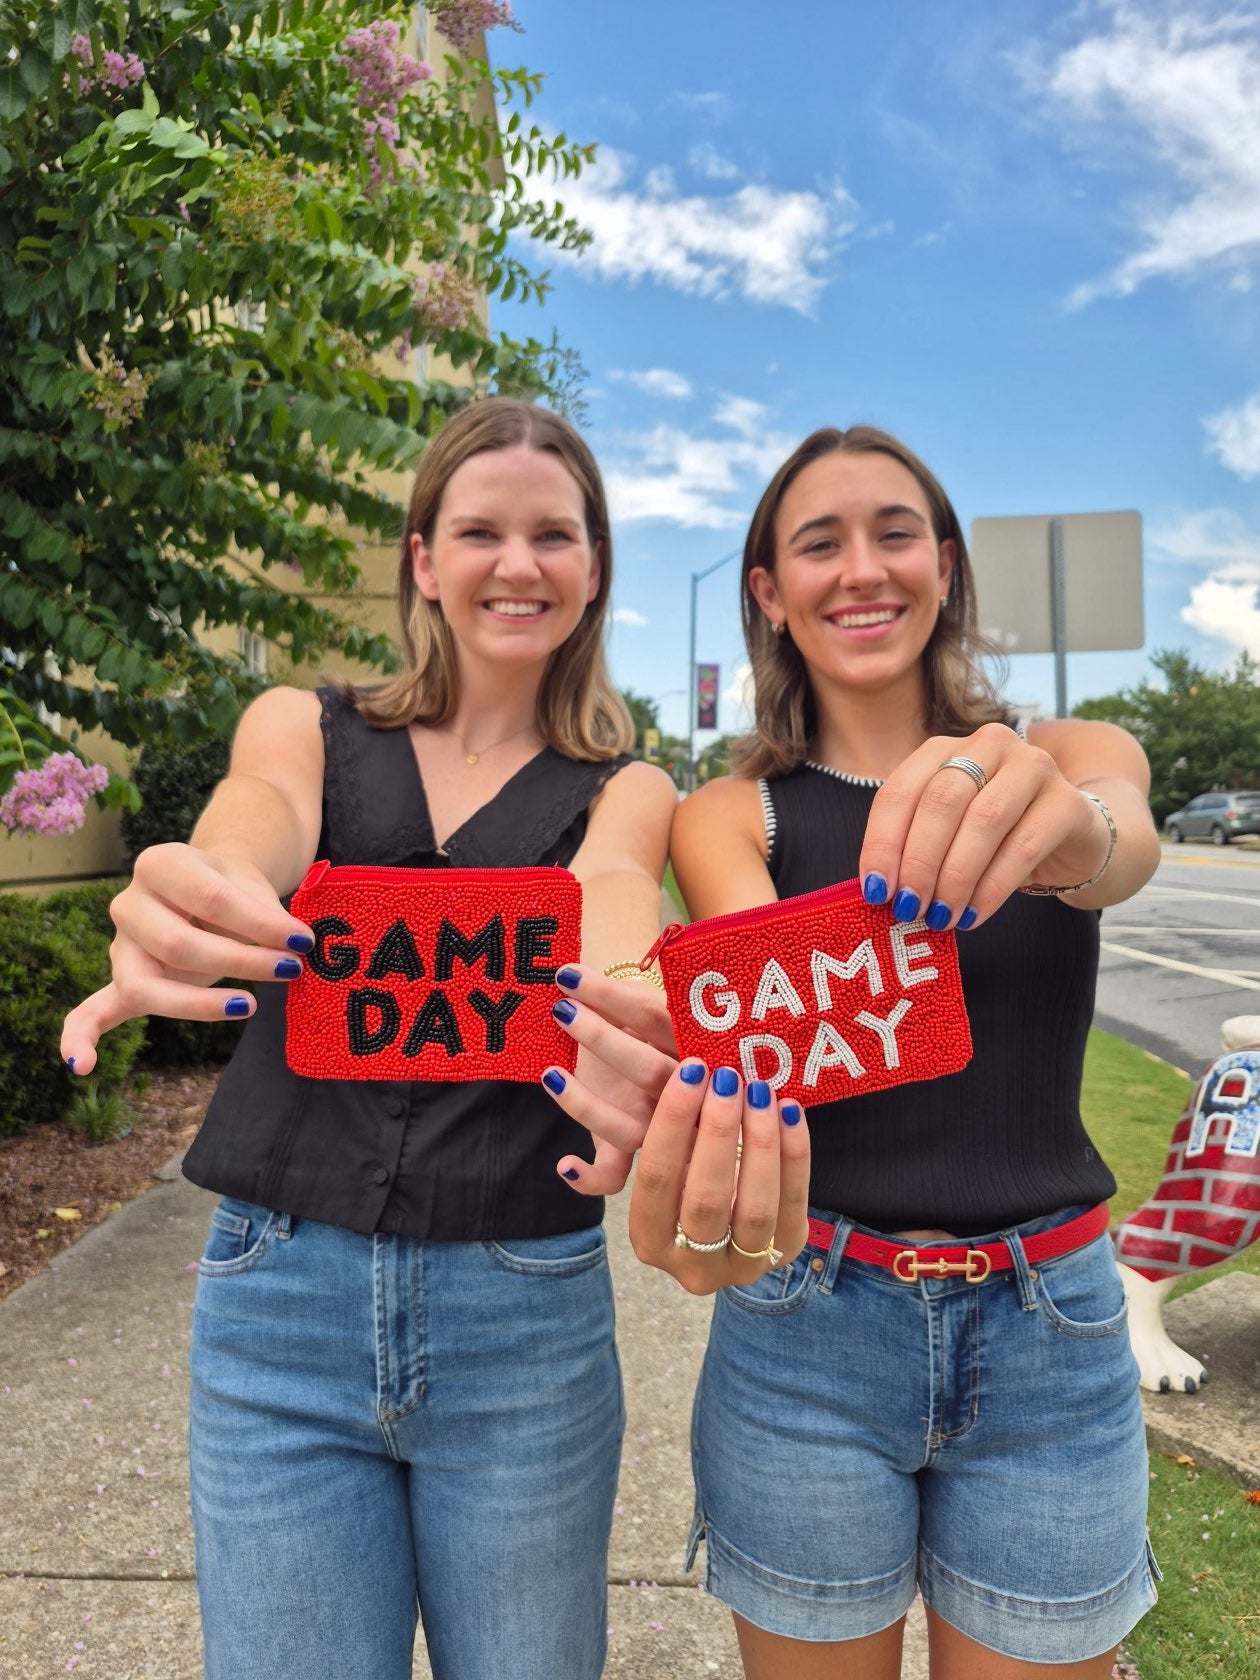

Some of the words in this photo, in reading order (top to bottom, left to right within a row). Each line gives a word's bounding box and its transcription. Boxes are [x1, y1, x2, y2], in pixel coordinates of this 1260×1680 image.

[308, 914, 559, 984] GAME
[688, 919, 939, 1033] GAME
[347, 987, 527, 1058] DAY
[738, 999, 914, 1091] DAY
